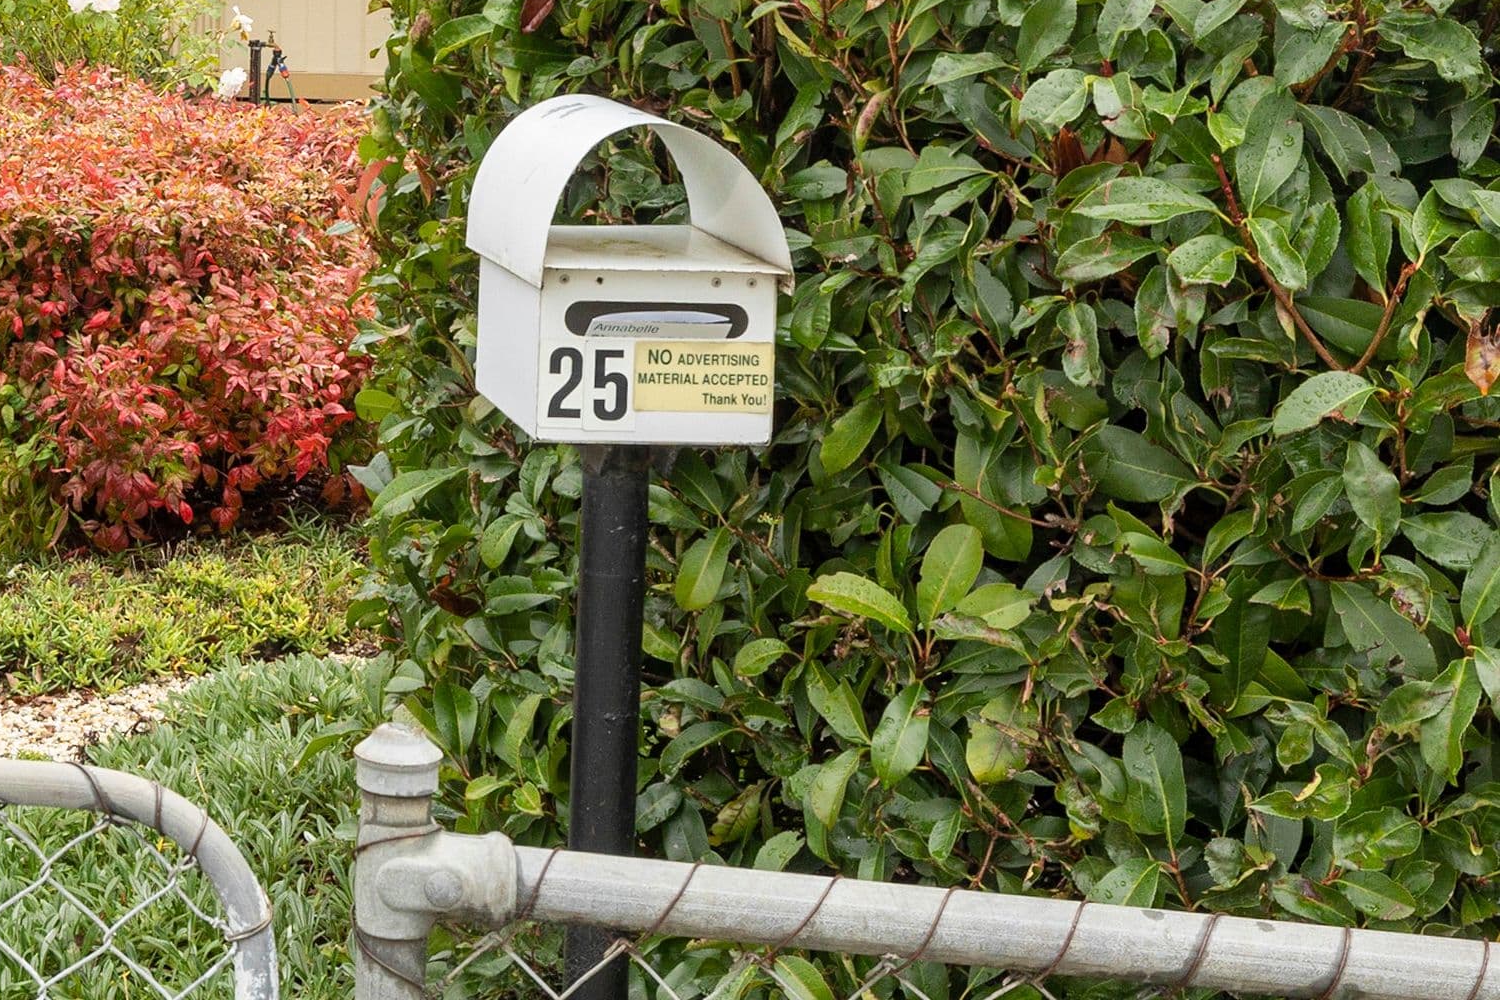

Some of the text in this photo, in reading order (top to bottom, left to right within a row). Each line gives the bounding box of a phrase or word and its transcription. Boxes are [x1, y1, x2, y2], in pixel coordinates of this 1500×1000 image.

[593, 323, 660, 335] Annabelle
[648, 349, 760, 367] NO ADVERTISING
[547, 347, 628, 422] 25
[637, 372, 769, 386] MATERIAL ACCEPTED
[702, 392, 767, 407] Thank You!
